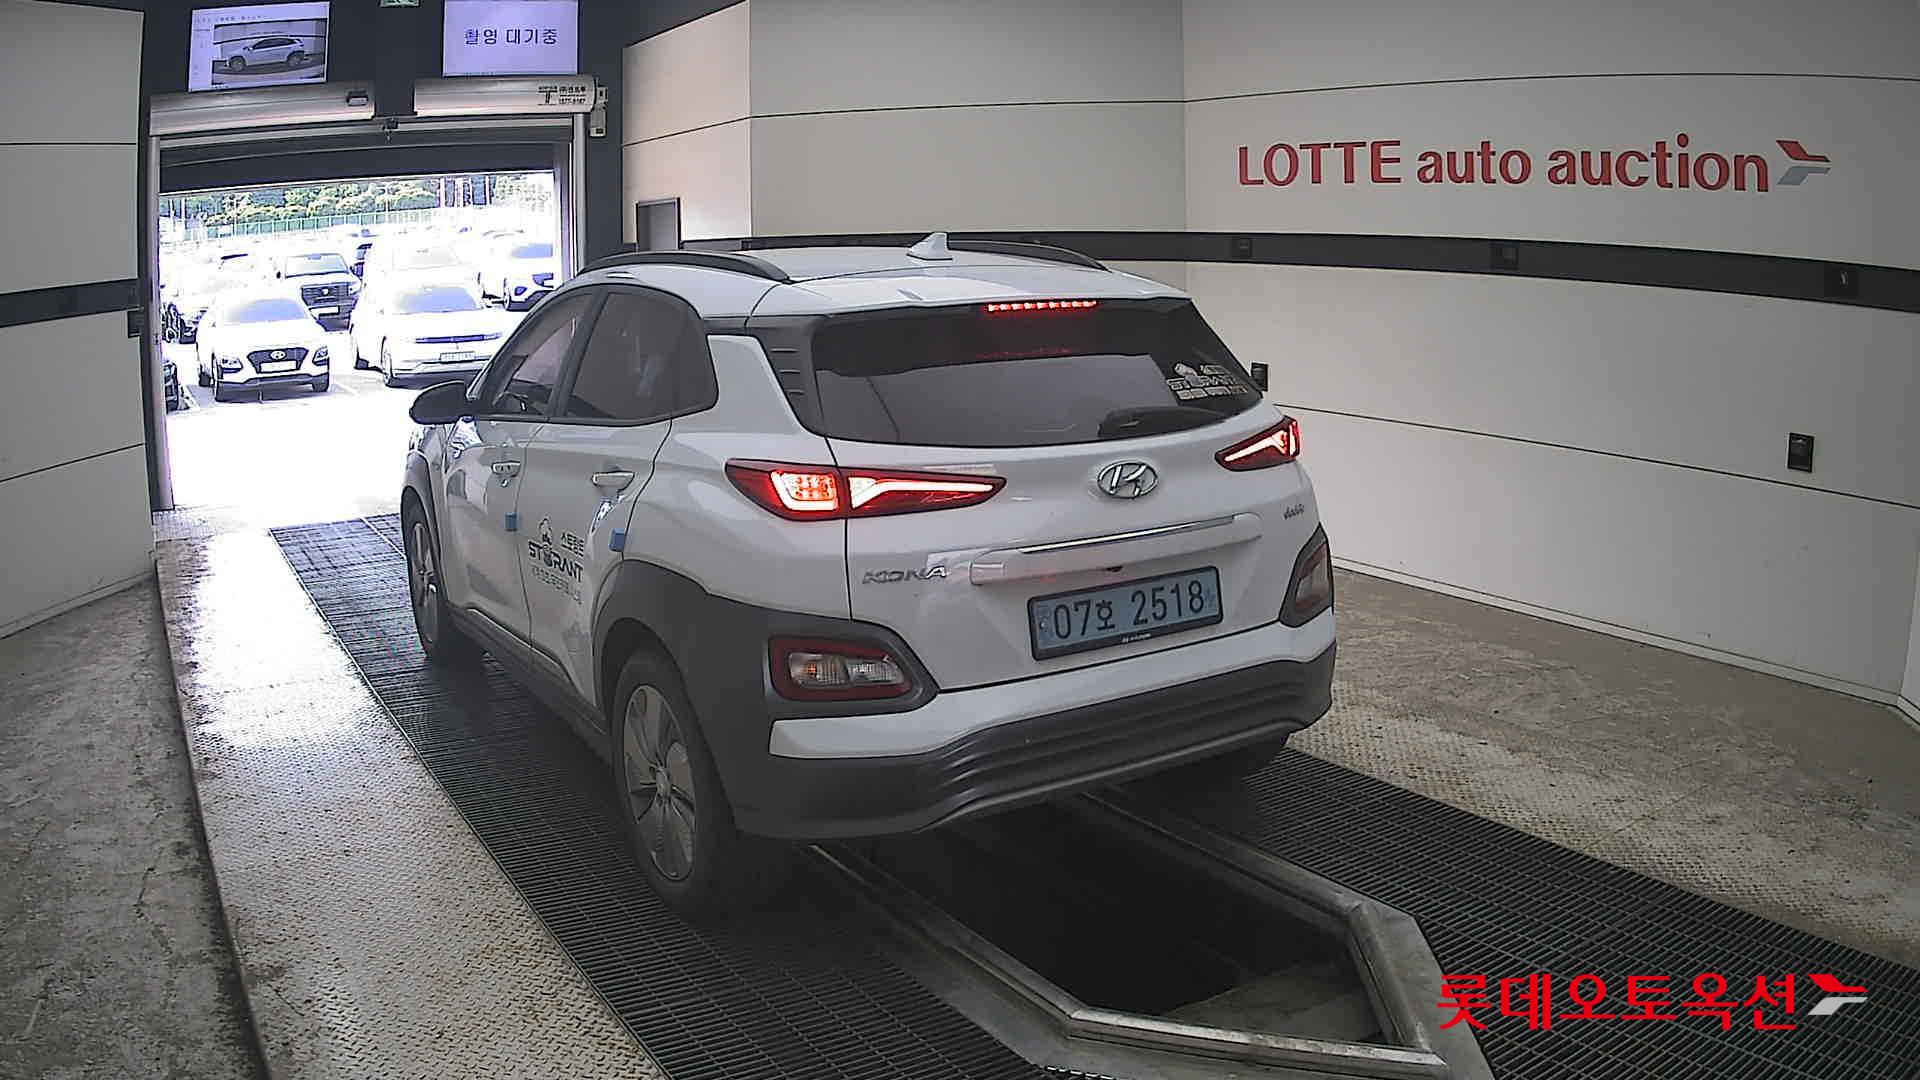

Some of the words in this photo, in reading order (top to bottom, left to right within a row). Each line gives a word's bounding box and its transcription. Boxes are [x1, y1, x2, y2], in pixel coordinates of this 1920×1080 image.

[506, 29, 557, 45] 대기중
[1238, 140, 1402, 187] LOTTE
[1417, 141, 1532, 184] auto
[1548, 133, 1768, 192] auction
[1054, 600, 1116, 640] 07호
[1131, 580, 1204, 626] 2518
